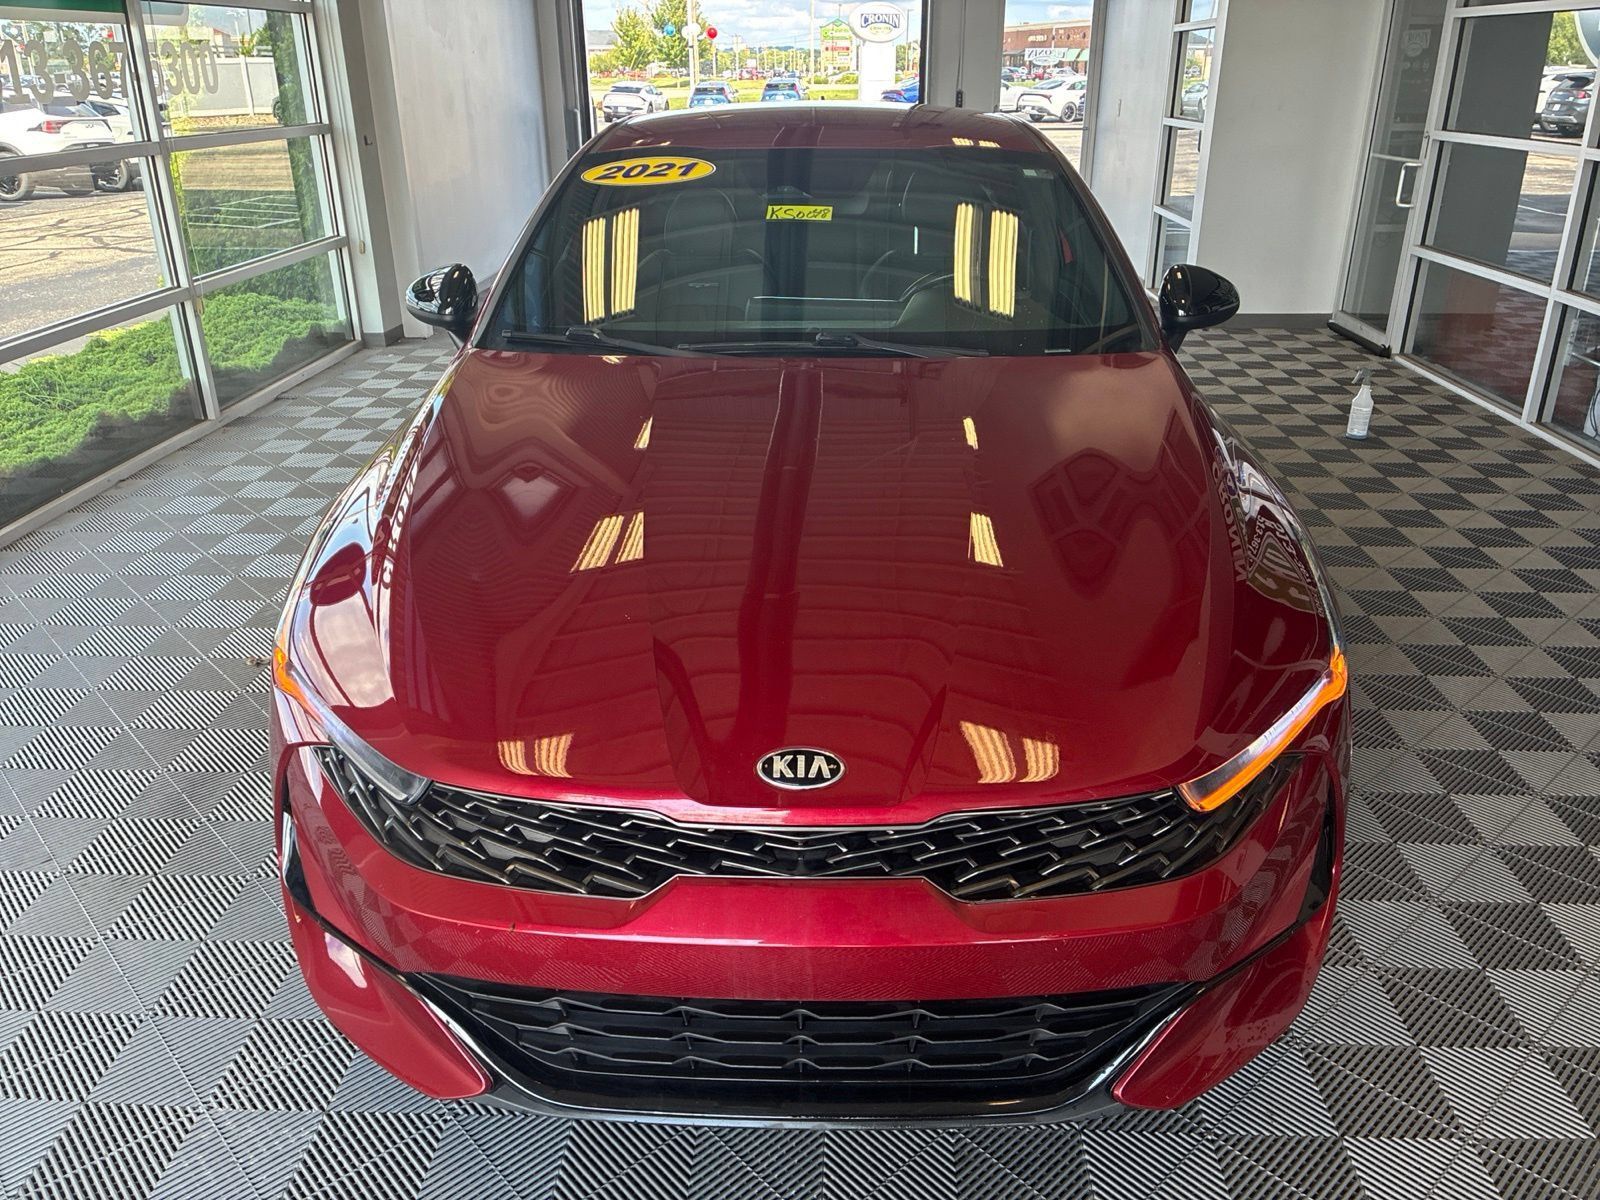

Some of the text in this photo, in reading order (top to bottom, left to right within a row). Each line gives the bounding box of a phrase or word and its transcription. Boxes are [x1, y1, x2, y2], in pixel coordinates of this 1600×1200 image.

[860, 13, 900, 29] CRONIN
[593, 162, 699, 181] 2021
[772, 754, 832, 779] KIA
